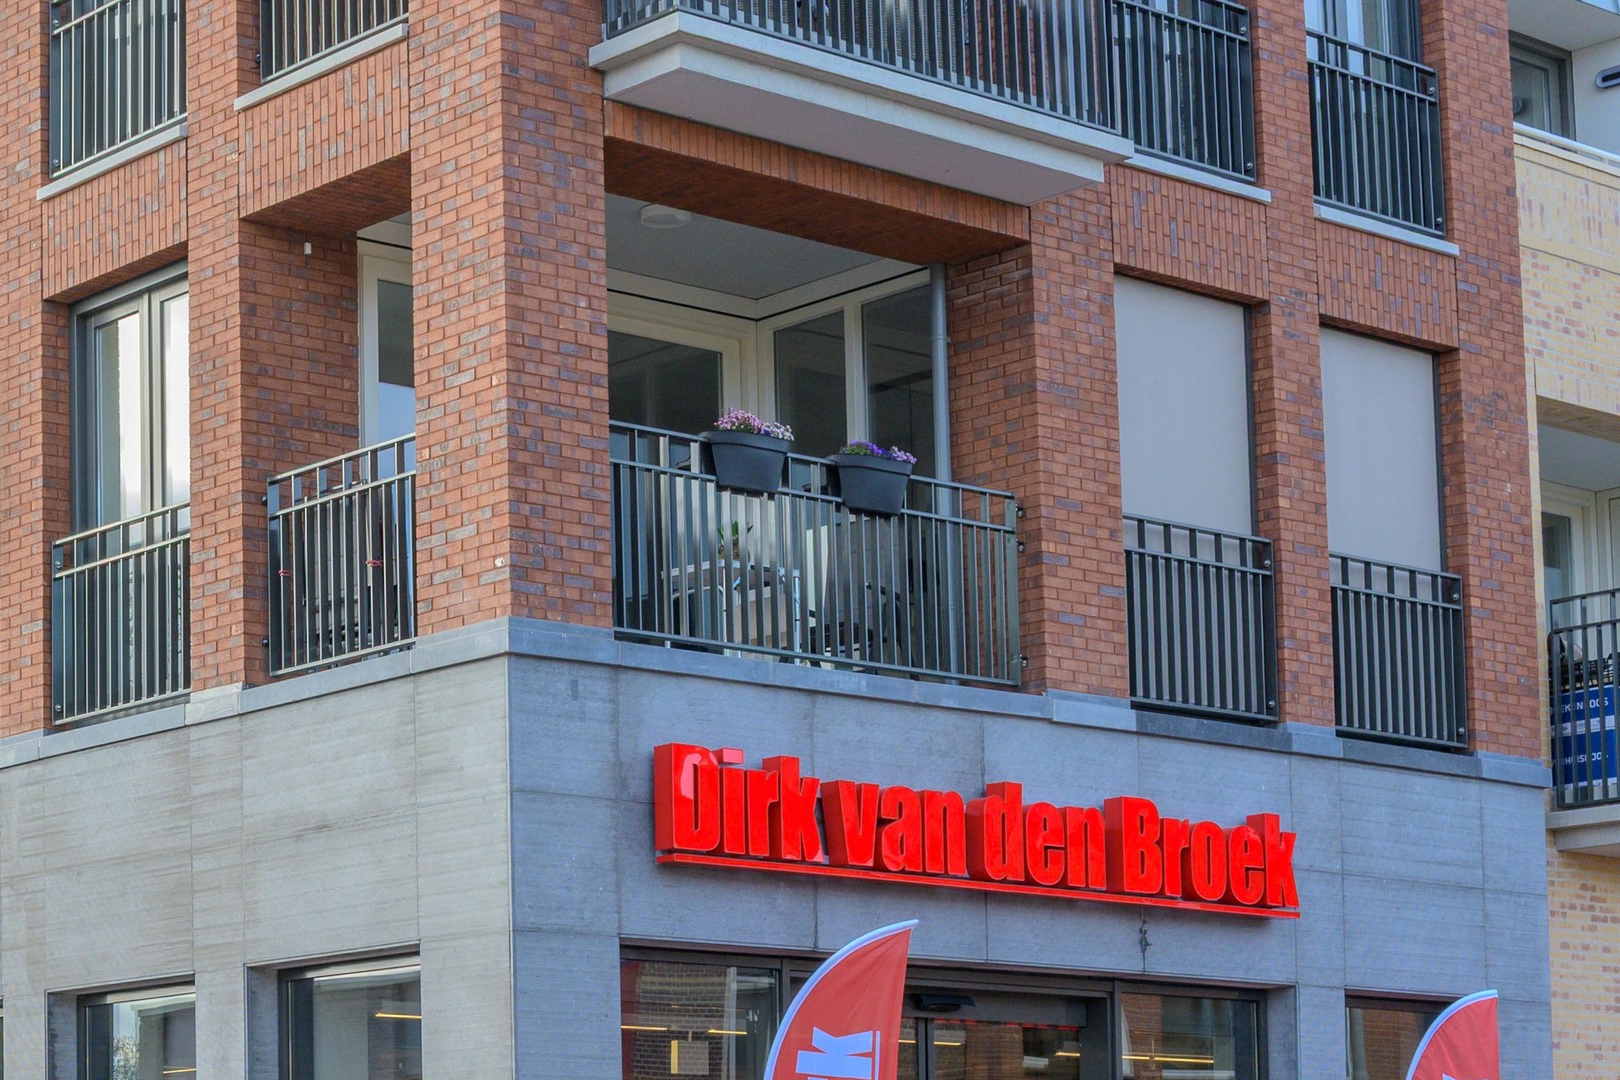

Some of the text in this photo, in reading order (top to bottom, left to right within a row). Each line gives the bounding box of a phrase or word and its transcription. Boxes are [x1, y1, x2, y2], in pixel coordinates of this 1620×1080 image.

[658, 743, 1299, 908] Dirk van den Broek
